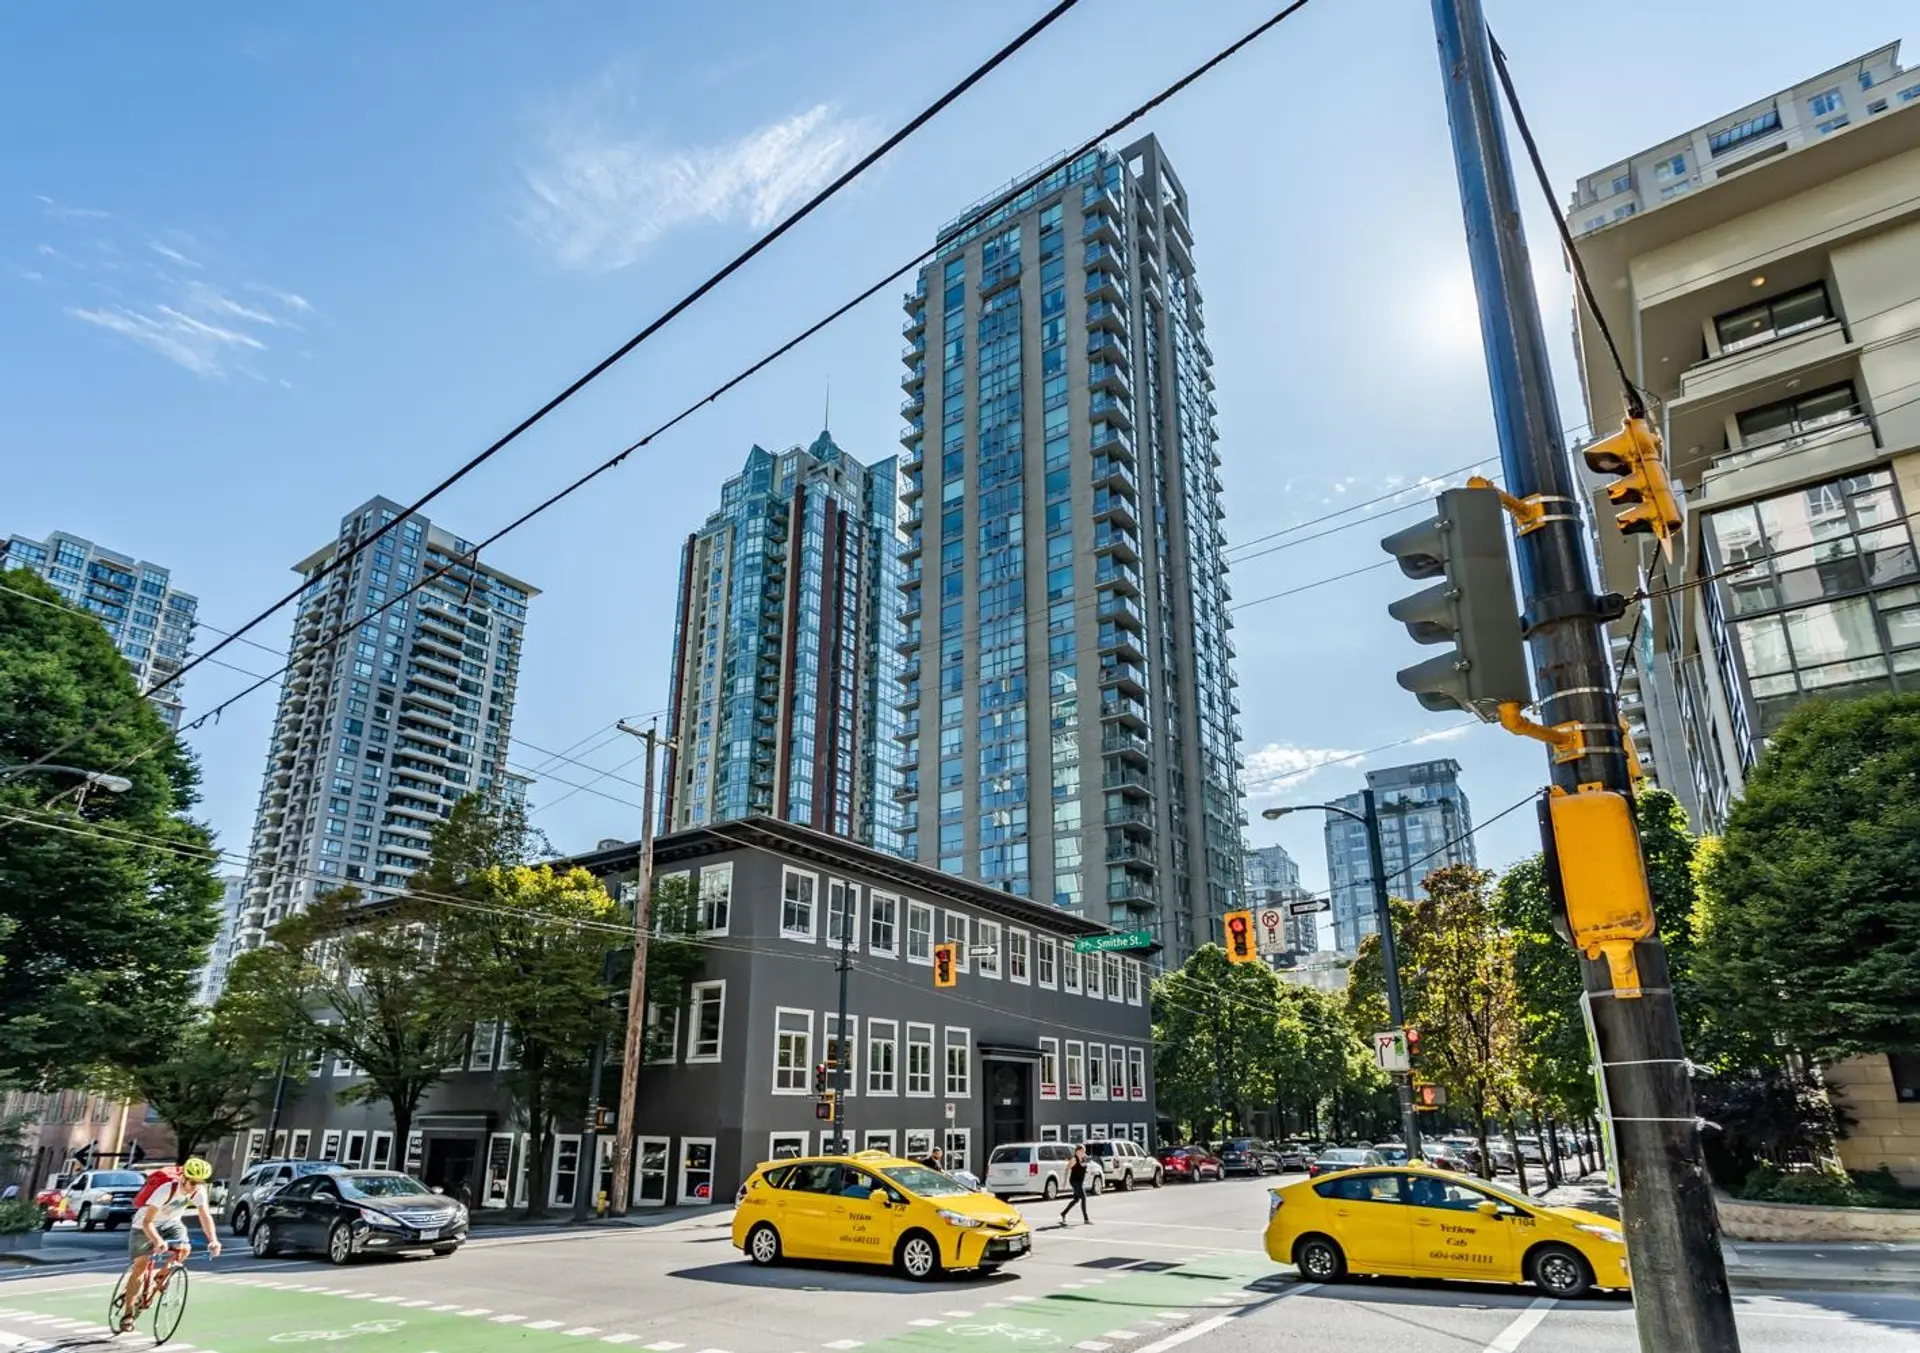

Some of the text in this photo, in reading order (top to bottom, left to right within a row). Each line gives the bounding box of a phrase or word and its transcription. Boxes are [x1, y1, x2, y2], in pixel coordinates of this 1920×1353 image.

[1096, 935, 1142, 949] Smithe St.
[1510, 1216, 1536, 1227] Y104
[1440, 1223, 1476, 1235] Yellow
[1446, 1237, 1468, 1247] Cab
